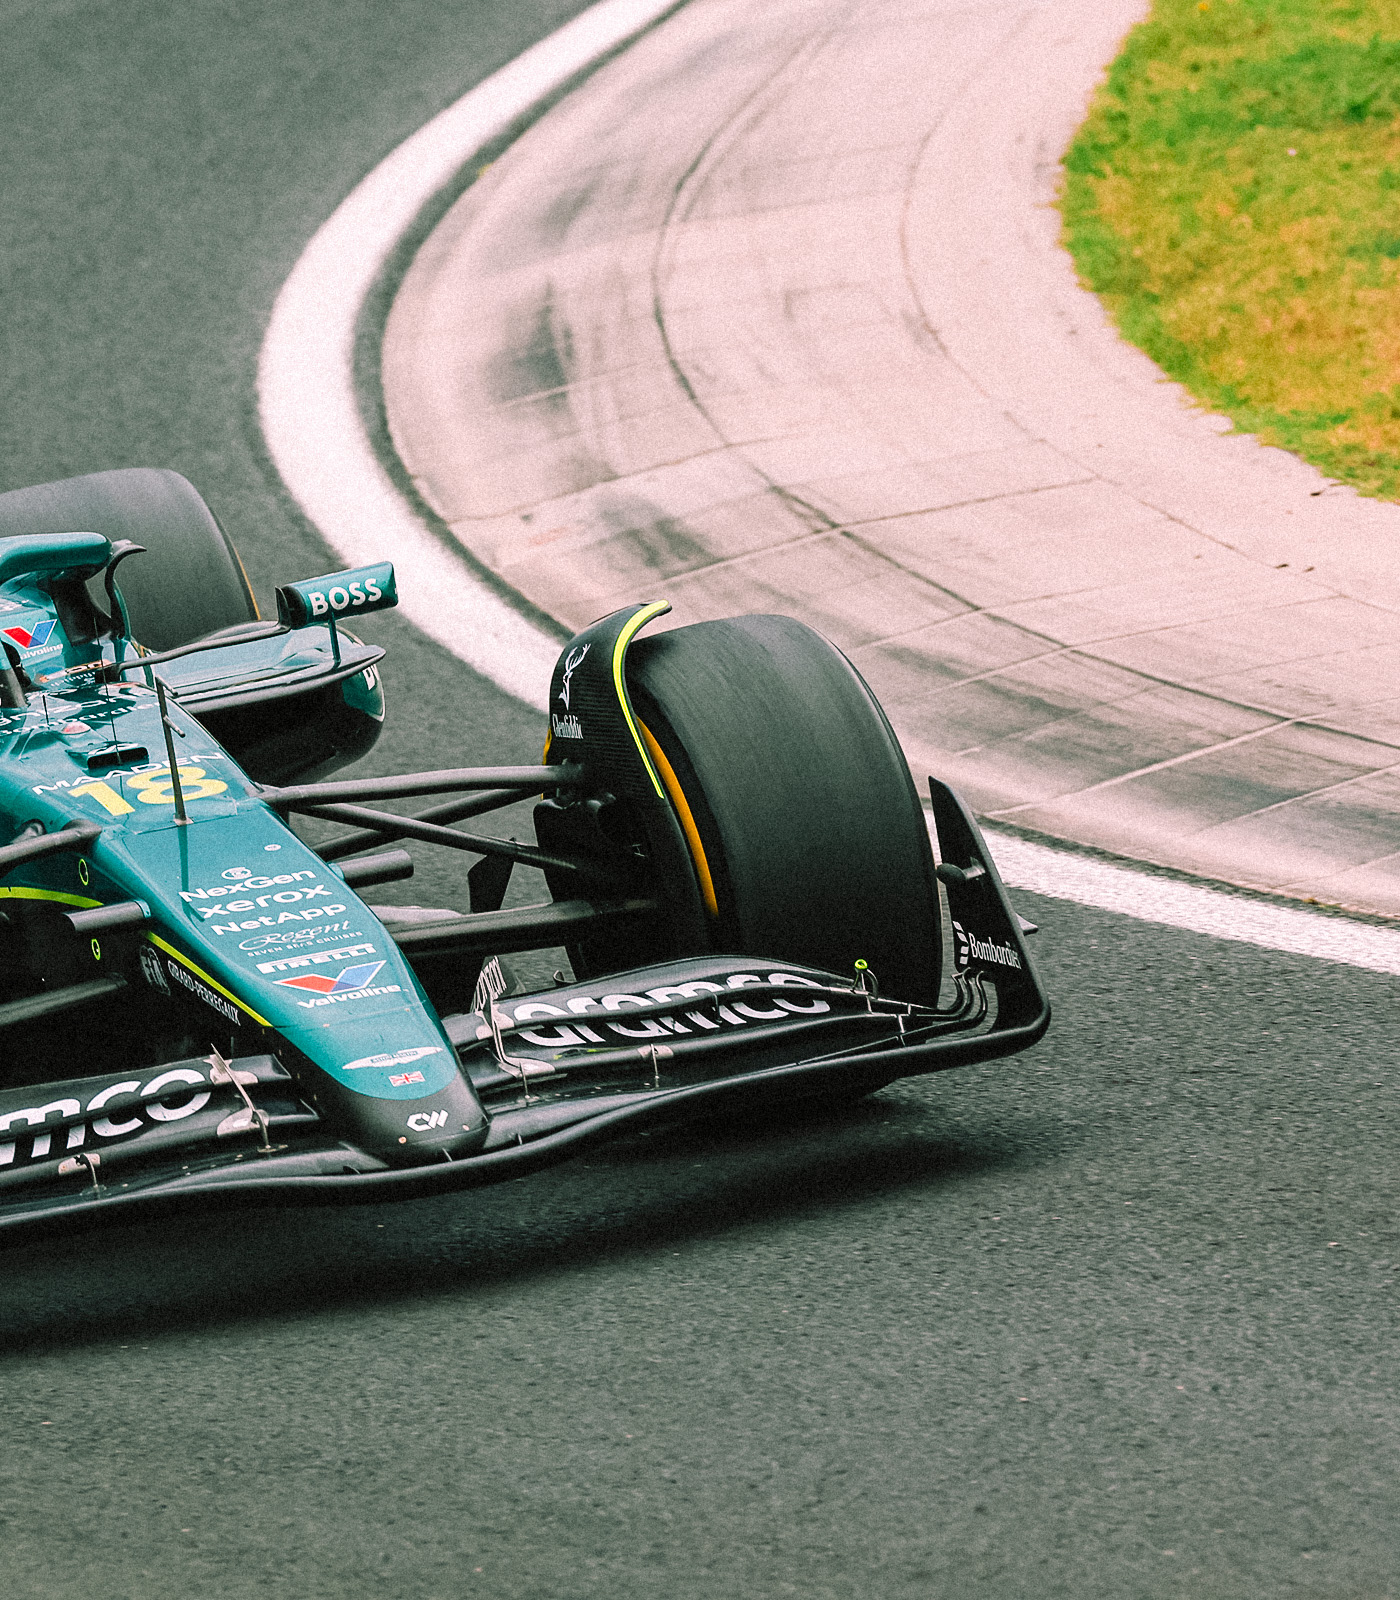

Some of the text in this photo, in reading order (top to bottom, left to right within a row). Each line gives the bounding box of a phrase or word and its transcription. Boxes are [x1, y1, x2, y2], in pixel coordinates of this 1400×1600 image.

[308, 578, 382, 616] BOSS
[21, 643, 64, 660] alvoline
[31, 752, 225, 796] MAADEN
[68, 766, 229, 817] 18
[178, 868, 317, 904] NexGen
[197, 884, 333, 919] xerox
[210, 903, 348, 936] NetApp
[238, 920, 351, 951] Regent
[247, 946, 283, 957] SEVEN
[316, 931, 363, 944] CRUISES
[255, 943, 377, 975] PIRELLI
[968, 932, 1022, 970] Bombardier
[296, 983, 403, 1009] Valvoline
[512, 972, 833, 1047] aramco
